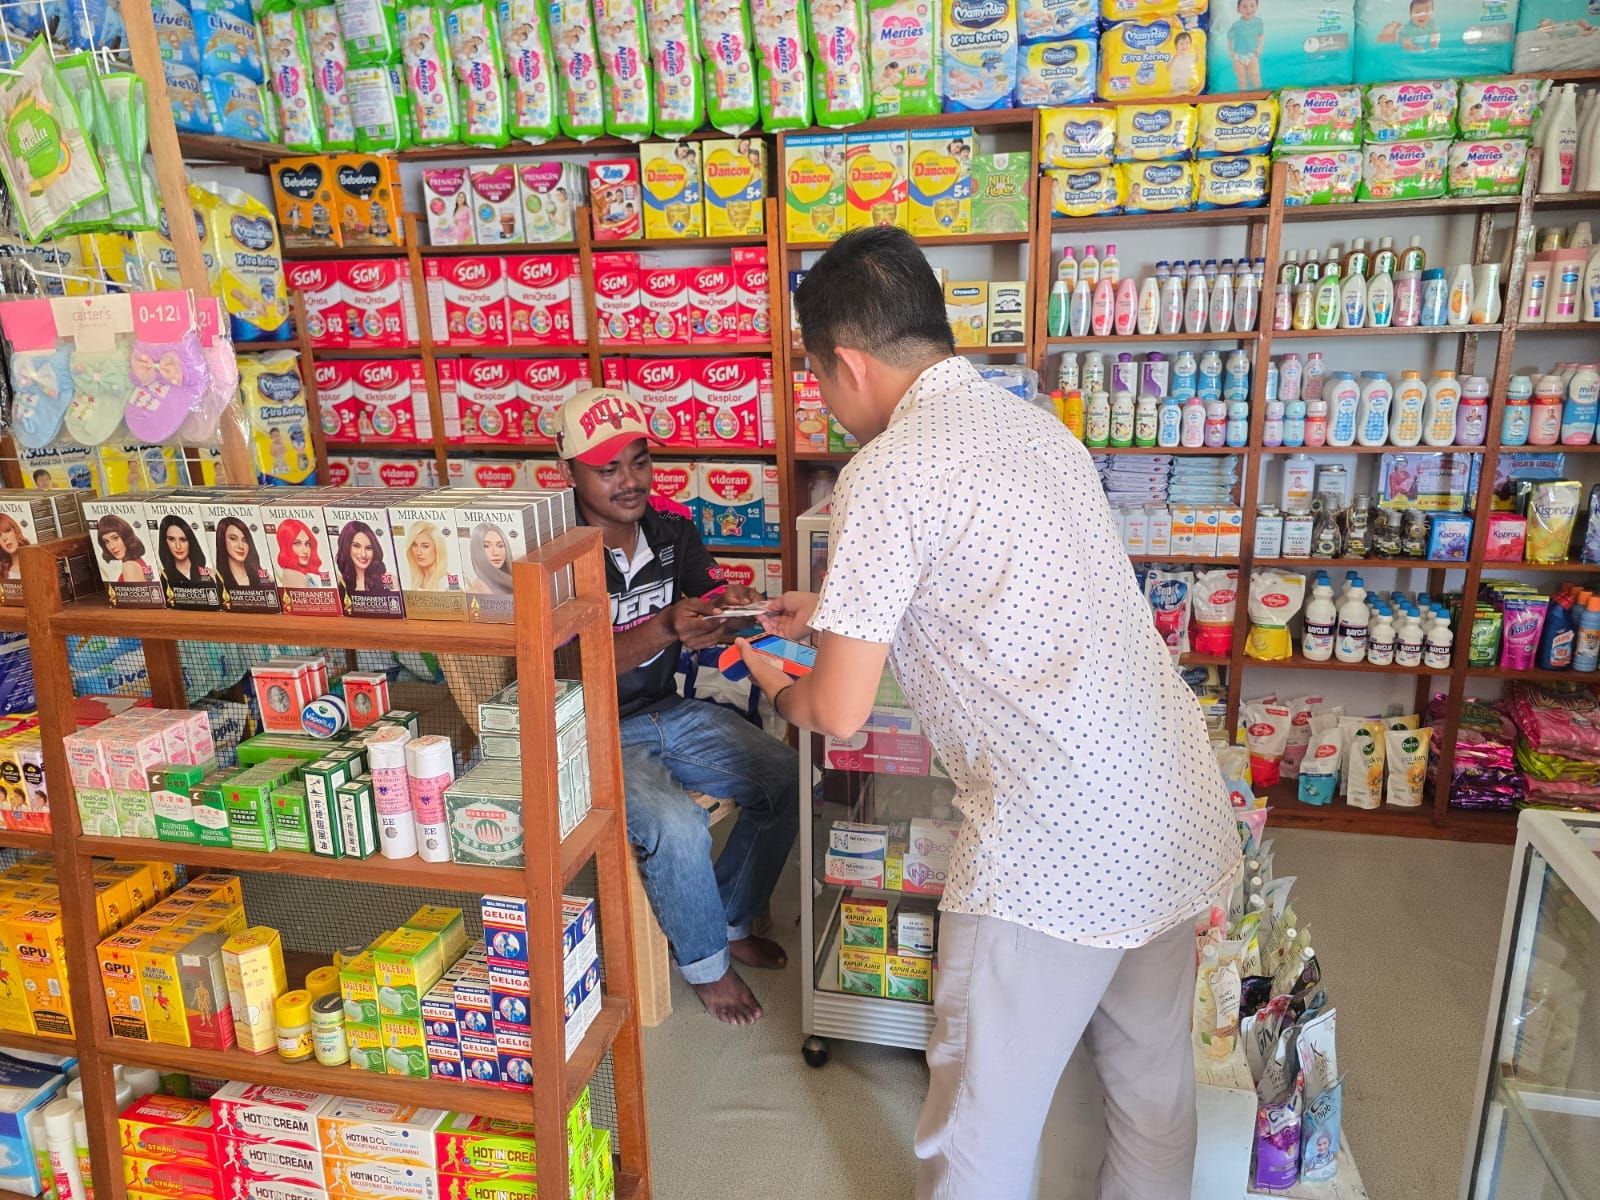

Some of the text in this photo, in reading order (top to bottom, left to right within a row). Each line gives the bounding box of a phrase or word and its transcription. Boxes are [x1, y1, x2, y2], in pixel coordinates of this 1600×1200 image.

[954, 1, 1006, 21] MamyPoko
[209, 16, 255, 40] Lively
[881, 26, 924, 41] Merries
[976, 29, 1010, 43] Kering
[1125, 28, 1169, 41] MamyPoko
[835, 26, 845, 67] Merries
[666, 40, 676, 78] Merries
[778, 36, 789, 75] Merries
[1142, 53, 1171, 63] Kering
[617, 46, 629, 82] Merries
[325, 58, 337, 96] Merries
[418, 58, 429, 96] Merries
[1303, 98, 1339, 109] Merries
[1397, 92, 1434, 103] Merries
[1482, 92, 1518, 103] Merries
[1389, 150, 1426, 162] Merries
[1467, 150, 1503, 162] Merries
[647, 169, 685, 182] Dancow
[708, 164, 751, 177] Dancow
[852, 168, 893, 181] Dancow
[914, 163, 957, 177] Dancow
[1303, 164, 1338, 175] Merries
[283, 177, 318, 188] Bebelac
[339, 175, 378, 186] Bebelove
[524, 173, 559, 182] PRENAGEN
[790, 171, 831, 184] Dancow
[684, 190, 699, 202] 5+
[746, 188, 761, 199] 5+
[892, 190, 906, 201] 1+
[953, 185, 970, 198] 5+
[829, 193, 844, 204] 3+
[294, 268, 322, 286] SGM
[352, 266, 380, 284] SGM
[457, 264, 487, 283] SGM
[522, 262, 553, 280] SGM
[602, 275, 628, 291] SGM
[650, 274, 676, 290] SGM
[698, 272, 724, 288] SGM
[650, 300, 678, 310] Eksplor
[72, 307, 112, 321] carter's
[675, 313, 688, 326] 1+
[628, 315, 641, 329] 3+
[315, 365, 336, 383] GM
[363, 365, 393, 384] SGM
[474, 364, 504, 383] SGM
[530, 364, 560, 383] SGM
[643, 365, 674, 384] SGM
[707, 365, 739, 383] SGM
[364, 392, 398, 403] Eksplor
[473, 391, 507, 402] Eksplor
[531, 392, 564, 403] Eksplor
[643, 392, 678, 403] Eksplor
[707, 392, 742, 403] Eksplor
[800, 389, 821, 398] SUN
[280, 406, 306, 421] Kering
[341, 409, 355, 424] 3+
[397, 408, 412, 424] 3+
[579, 396, 641, 440] BULLS
[677, 410, 691, 426] 1+
[740, 409, 756, 426] 1+
[382, 468, 416, 479] vidoran
[478, 471, 512, 482] vidoran
[710, 475, 749, 486] vidoran
[91, 505, 136, 515] MIRANDA
[151, 505, 194, 516] MIRANDA
[208, 506, 253, 517] MIRANDA
[268, 509, 315, 520] MIRANDA
[333, 510, 378, 522] MIRANDA
[398, 509, 447, 521] MIRANDA
[1534, 503, 1576, 519] Kispray
[464, 511, 514, 523] MIRANDA
[1438, 530, 1467, 541] Kispray
[1493, 529, 1521, 540] Kispray
[199, 567, 209, 576] 3D
[115, 586, 148, 594] PERMANENT
[173, 587, 205, 595] PERMANENT
[229, 589, 263, 597] PERMANENT
[290, 591, 334, 599] PERMANENT
[307, 598, 336, 606] COLOR
[352, 594, 388, 602] PERMANENT
[368, 600, 388, 608] COLOR
[305, 711, 334, 729] VapoRub
[382, 818, 395, 826] EE
[424, 827, 437, 835] EE
[484, 909, 524, 922] GELIGA
[19, 945, 48, 958] GPU
[104, 962, 132, 975] GPU
[378, 962, 412, 976] EAGLE BALM
[889, 966, 910, 974] KAPUR
[343, 981, 373, 993] EAGLE BALM
[490, 975, 530, 987] GELIGA
[456, 994, 489, 1004] GELIGA
[423, 1008, 454, 1017] GELIGA
[463, 1042, 496, 1053] GELIGA
[497, 1036, 531, 1047] GELIG
[429, 1047, 459, 1057] GELIGA
[292, 1090, 320, 1100] CREAM
[243, 1111, 309, 1132] HOT IN CREAM
[369, 1136, 388, 1146] DCL
[250, 1148, 313, 1171] HOT CREAM
[473, 1146, 536, 1163] HOT CREA
[373, 1174, 392, 1184] DCL
[256, 1186, 275, 1199] HOT
